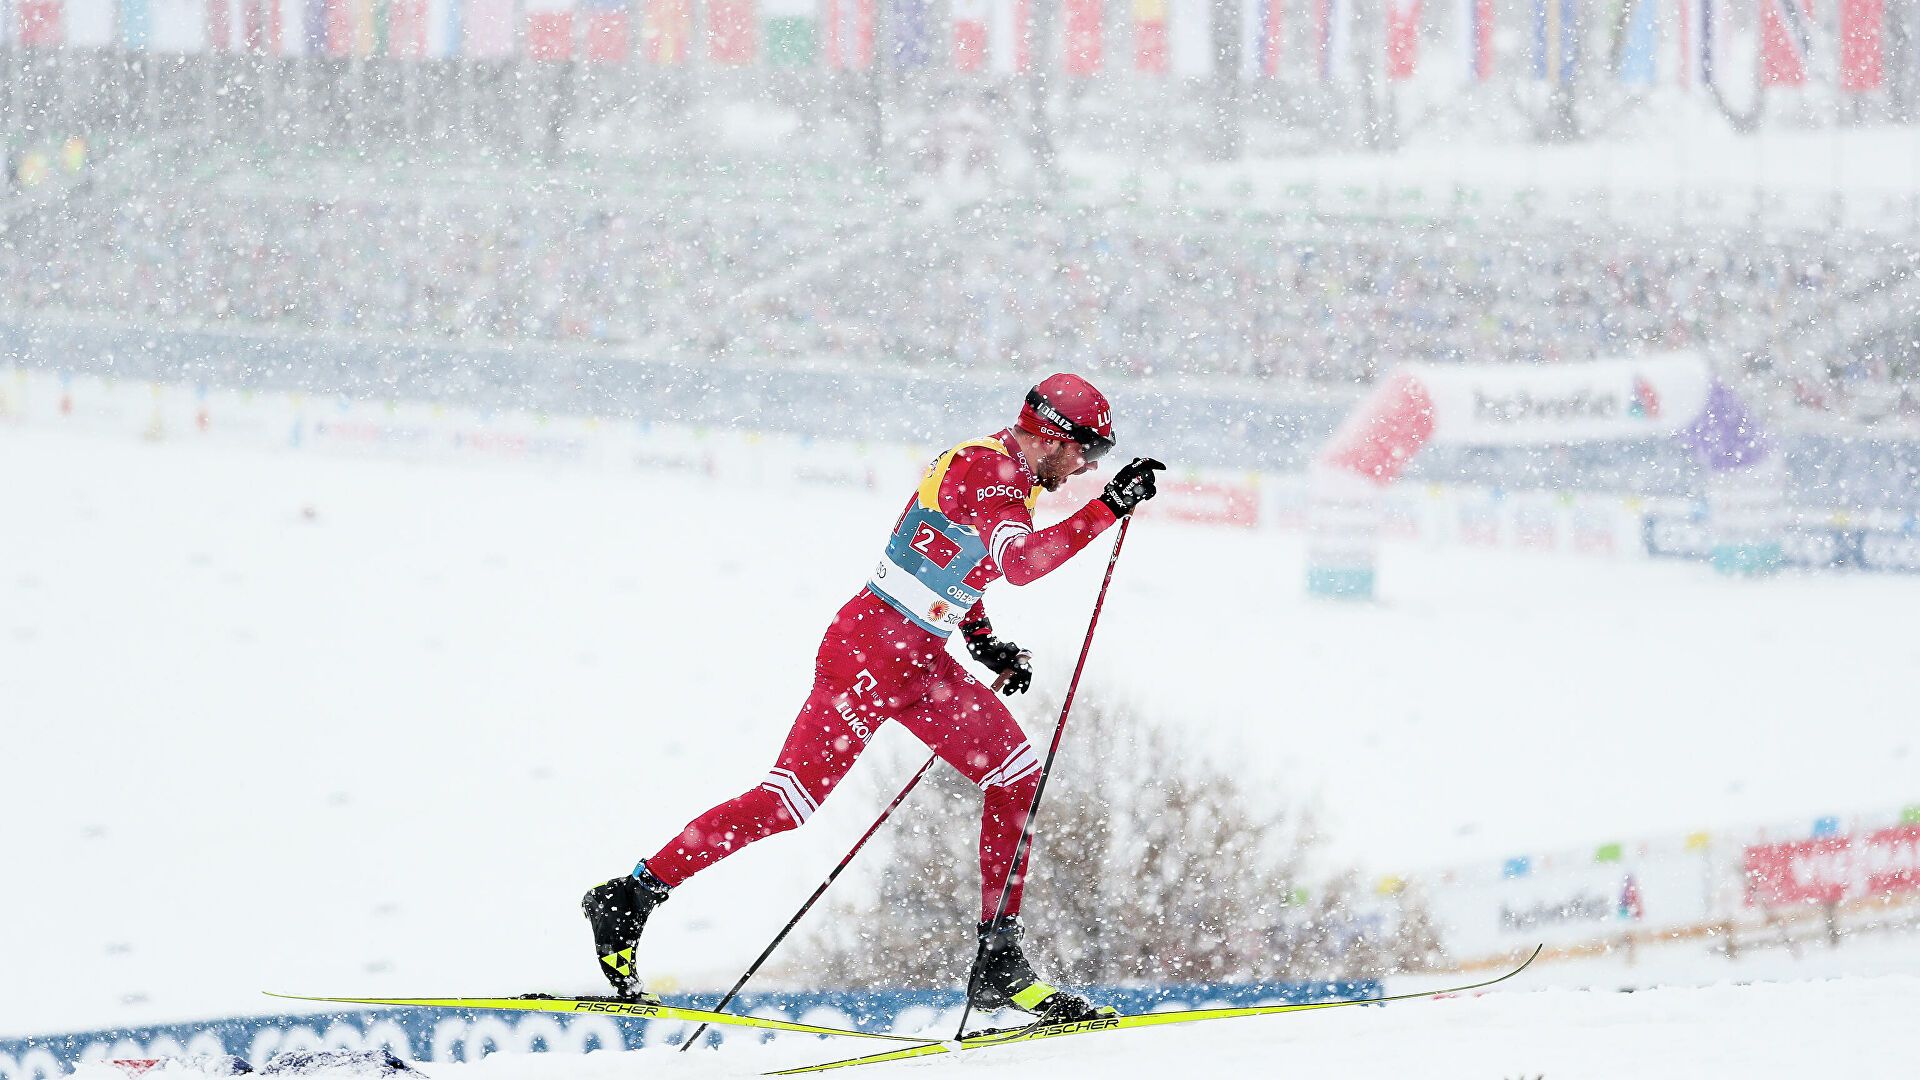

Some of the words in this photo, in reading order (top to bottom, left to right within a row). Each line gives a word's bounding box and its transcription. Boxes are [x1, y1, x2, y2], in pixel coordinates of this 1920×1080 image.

[976, 484, 1024, 502] BOSCO
[1109, 490, 1127, 508] SWIX
[914, 528, 935, 553] 2
[574, 1002, 659, 1017] FISCHER
[1029, 1018, 1120, 1039] FISCHER
